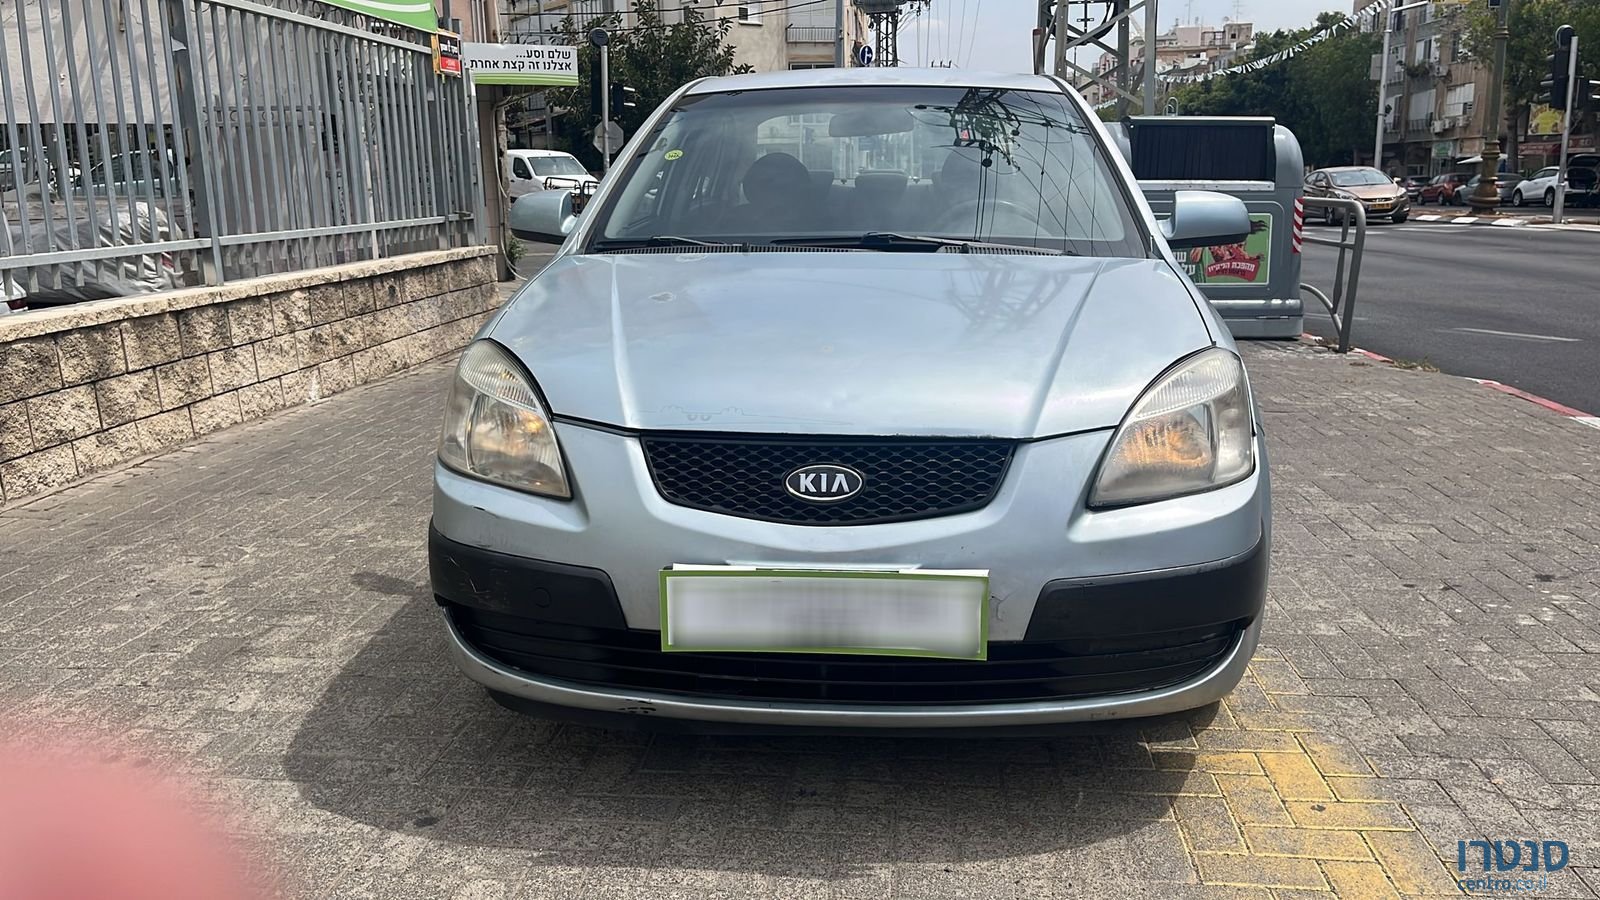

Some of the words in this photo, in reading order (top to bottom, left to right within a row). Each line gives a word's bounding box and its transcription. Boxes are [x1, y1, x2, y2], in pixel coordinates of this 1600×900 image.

[516, 49, 544, 59] וסע...
[548, 49, 571, 59] שלם
[470, 59, 500, 69] אחרת
[503, 60, 525, 72] קצת
[528, 61, 540, 70] זה
[543, 60, 572, 71] אצלנו
[799, 473, 850, 493] KIA
